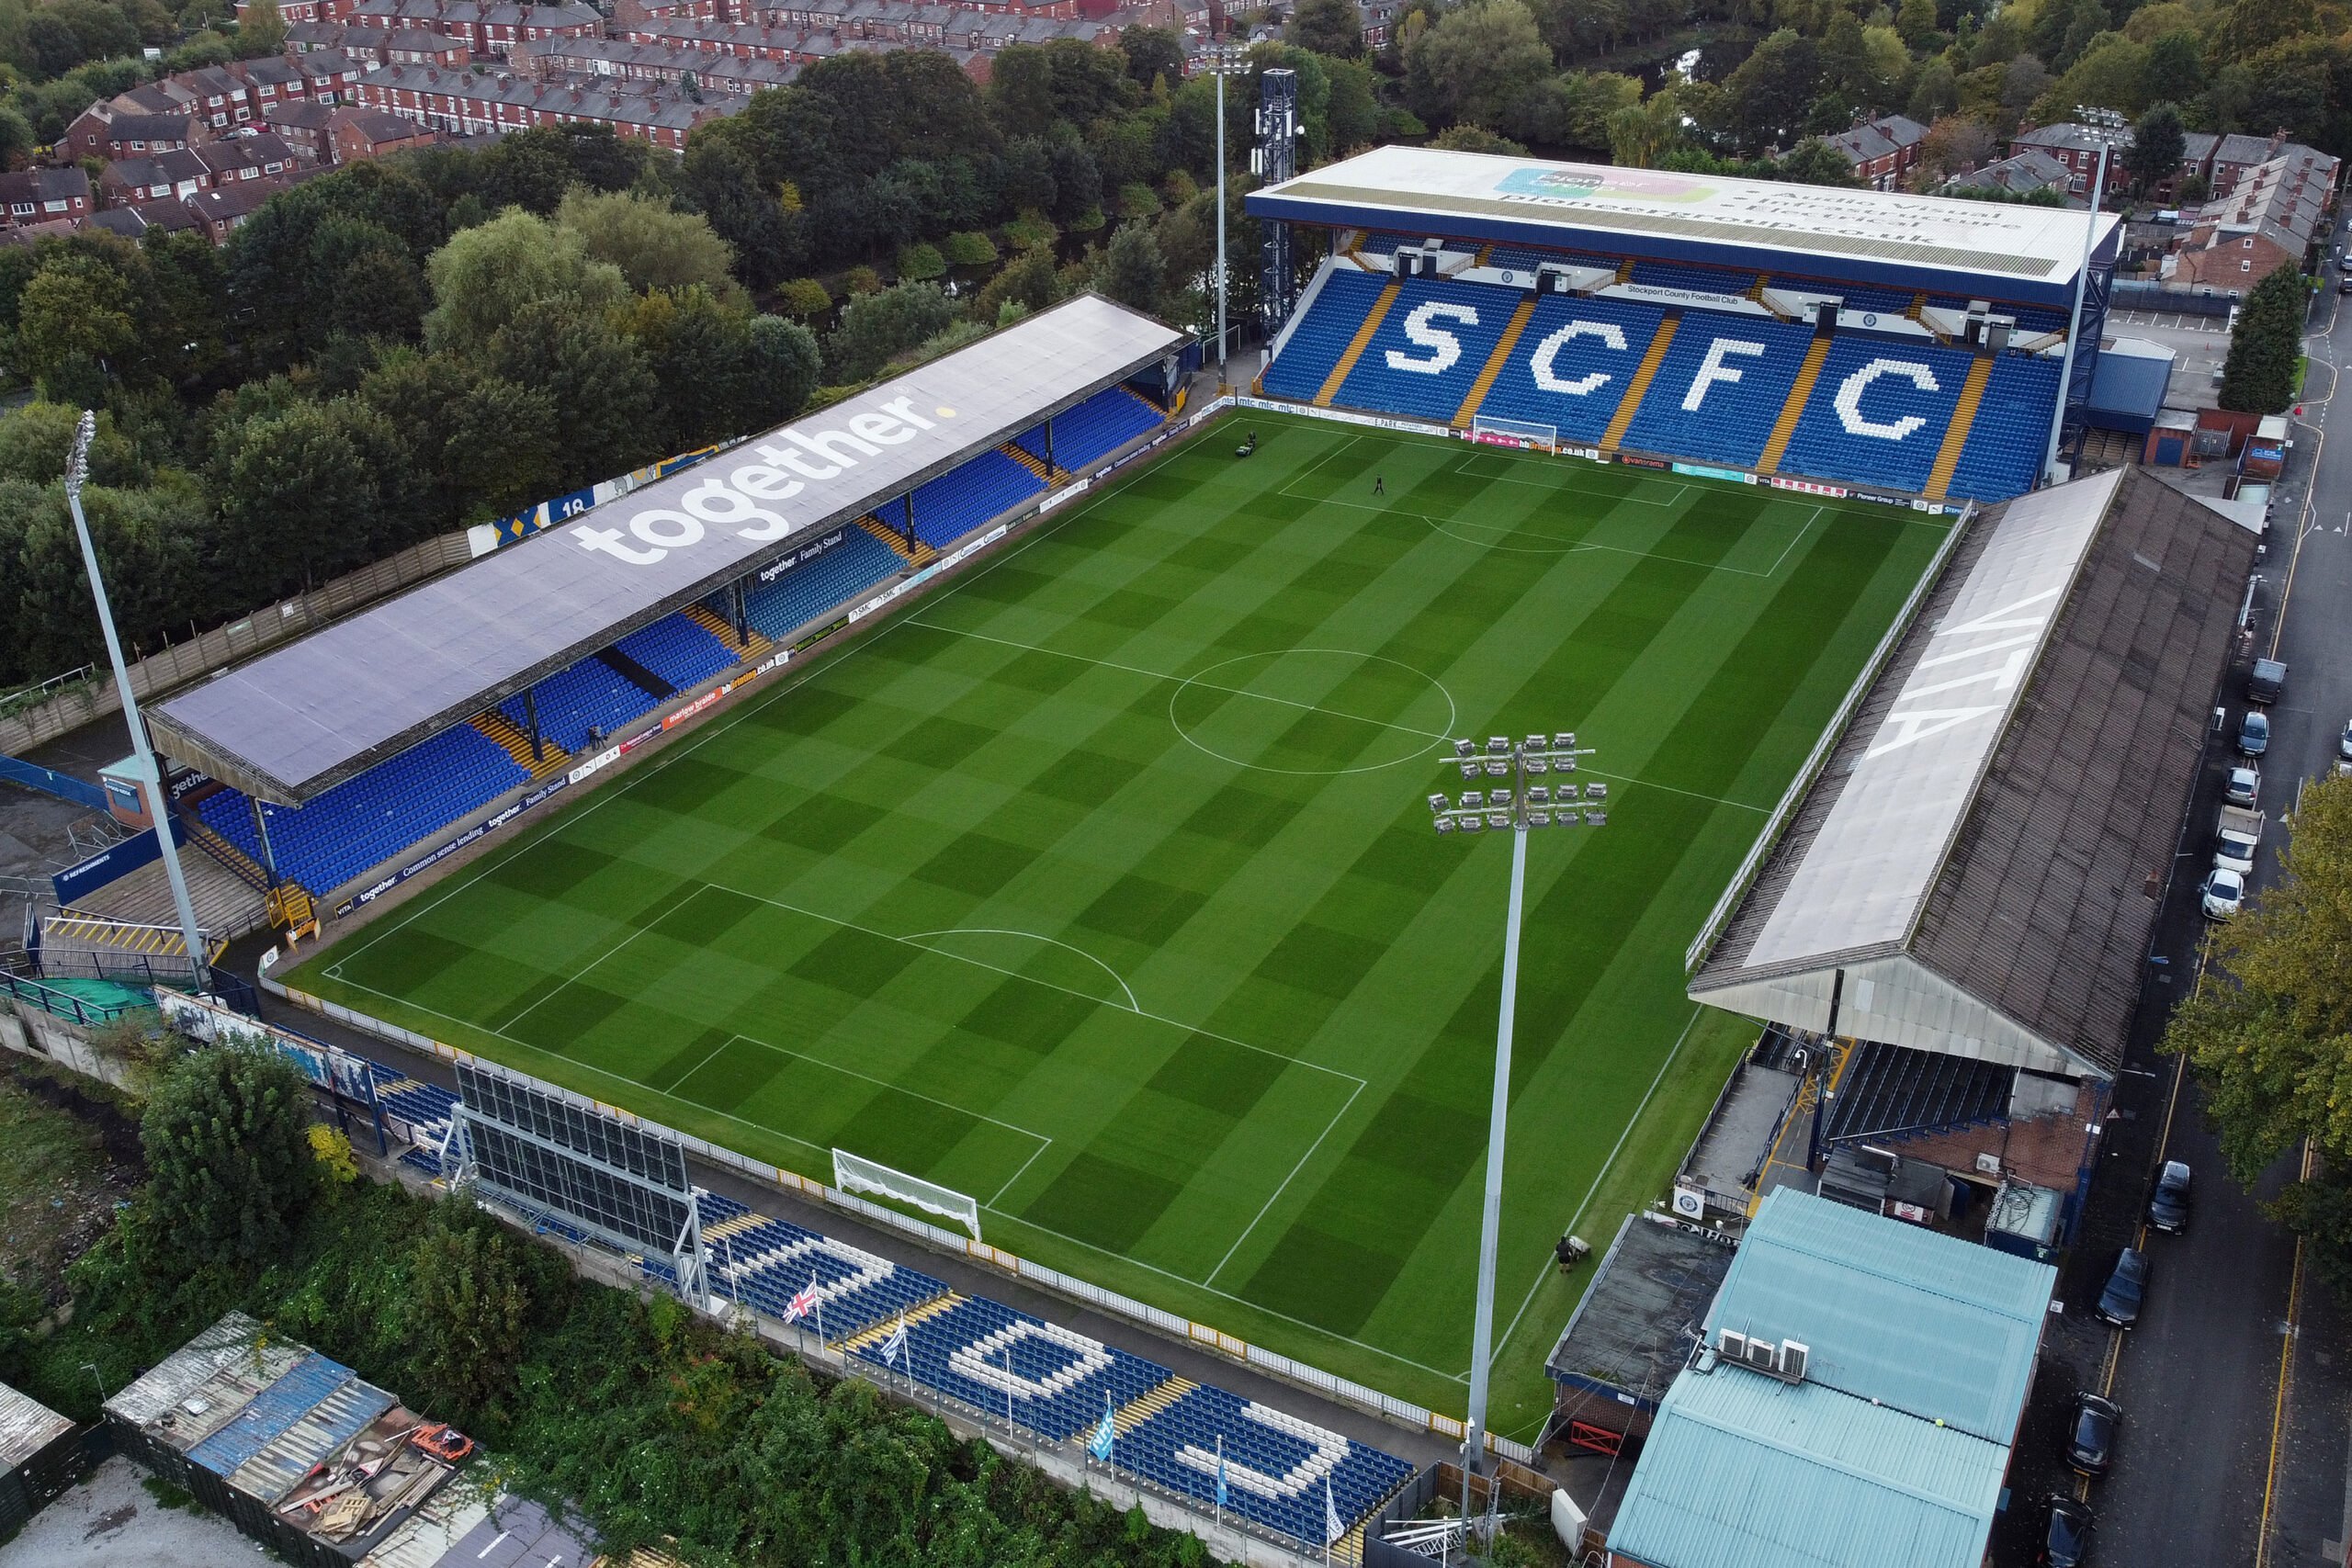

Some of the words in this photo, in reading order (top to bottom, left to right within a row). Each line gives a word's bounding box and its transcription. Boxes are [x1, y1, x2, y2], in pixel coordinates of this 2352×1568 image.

[1628, 285, 1663, 297] Stockport
[1664, 289, 1690, 301] County
[1690, 292, 1720, 303] Football
[1721, 296, 1738, 305] Club
[1239, 398, 1255, 407] mtc
[1258, 401, 1274, 410] mtc
[1278, 404, 1295, 412] mtc
[799, 543, 823, 561] Family
[823, 530, 842, 549] Stand
[1865, 586, 2060, 760] VITA
[669, 704, 695, 724] marlow
[526, 789, 548, 807] Family
[548, 776, 566, 794] Stand
[402, 854, 436, 877] Common
[436, 842, 457, 858] sense
[457, 826, 484, 846] lending
[337, 905, 352, 915] VITA
